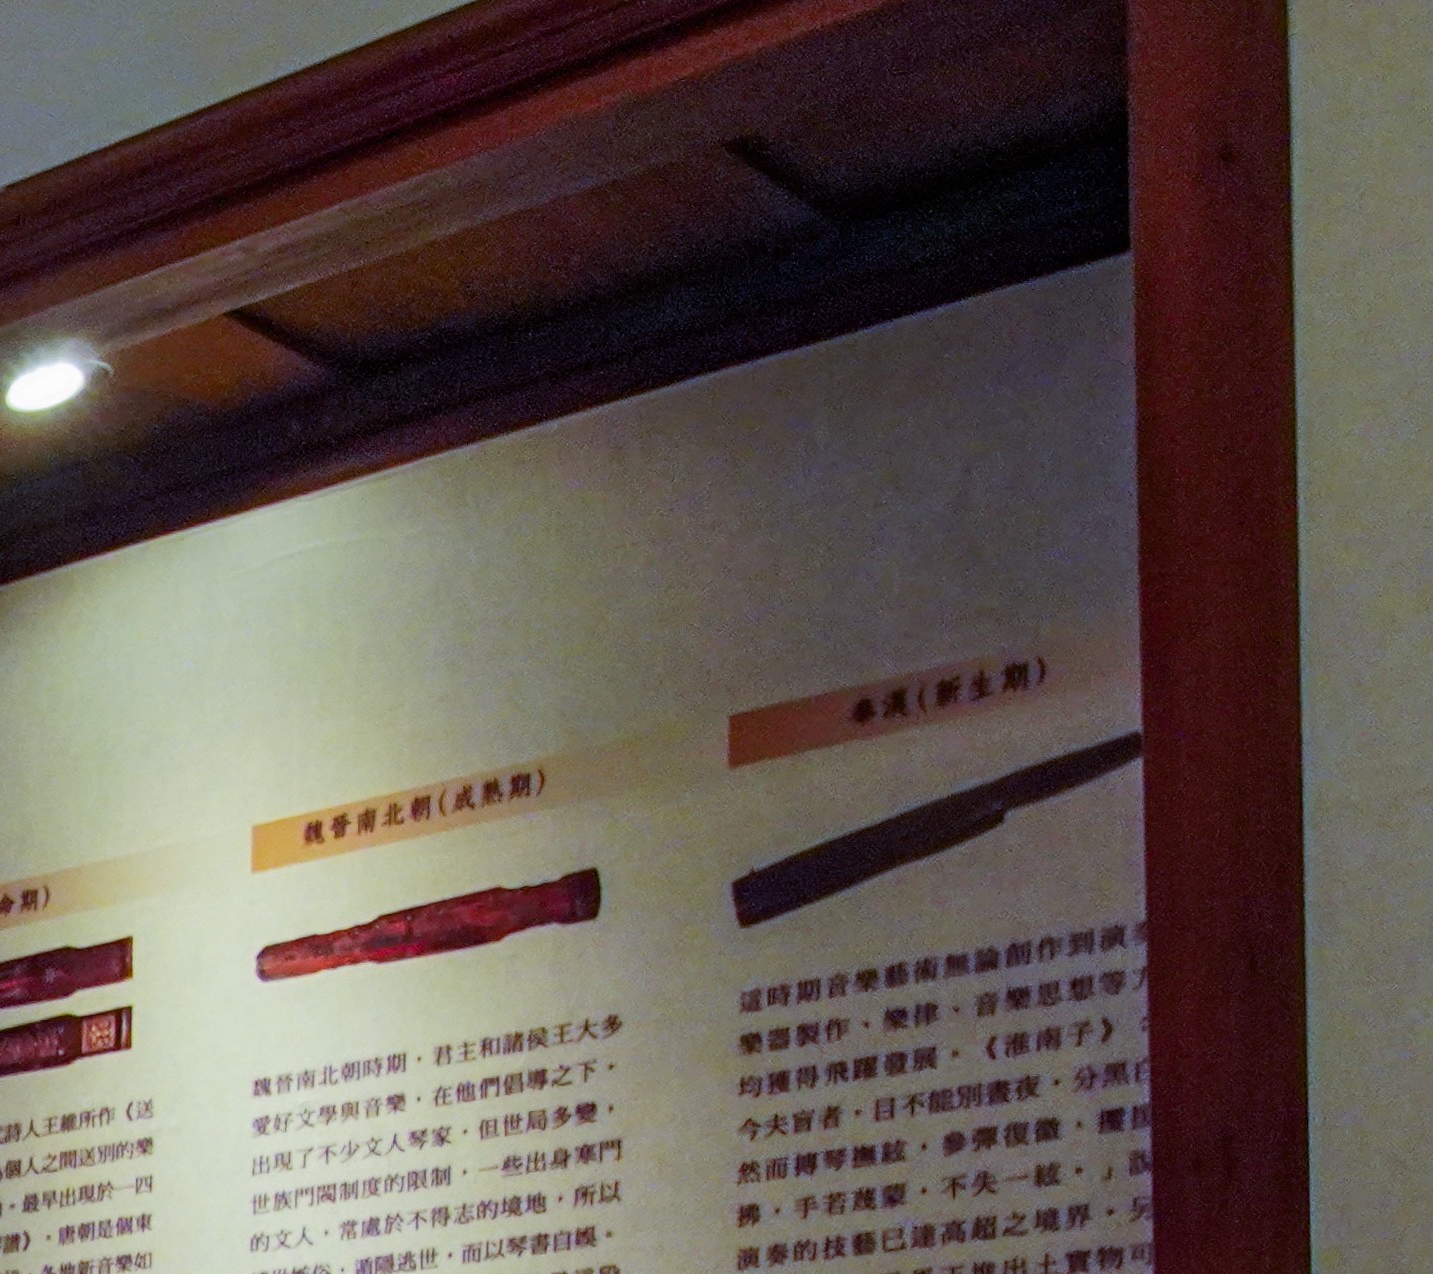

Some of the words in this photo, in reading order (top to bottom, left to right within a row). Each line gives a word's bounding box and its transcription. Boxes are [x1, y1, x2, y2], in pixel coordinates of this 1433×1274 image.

[303, 769, 547, 844] 魏晉南北朝(成熟期)
